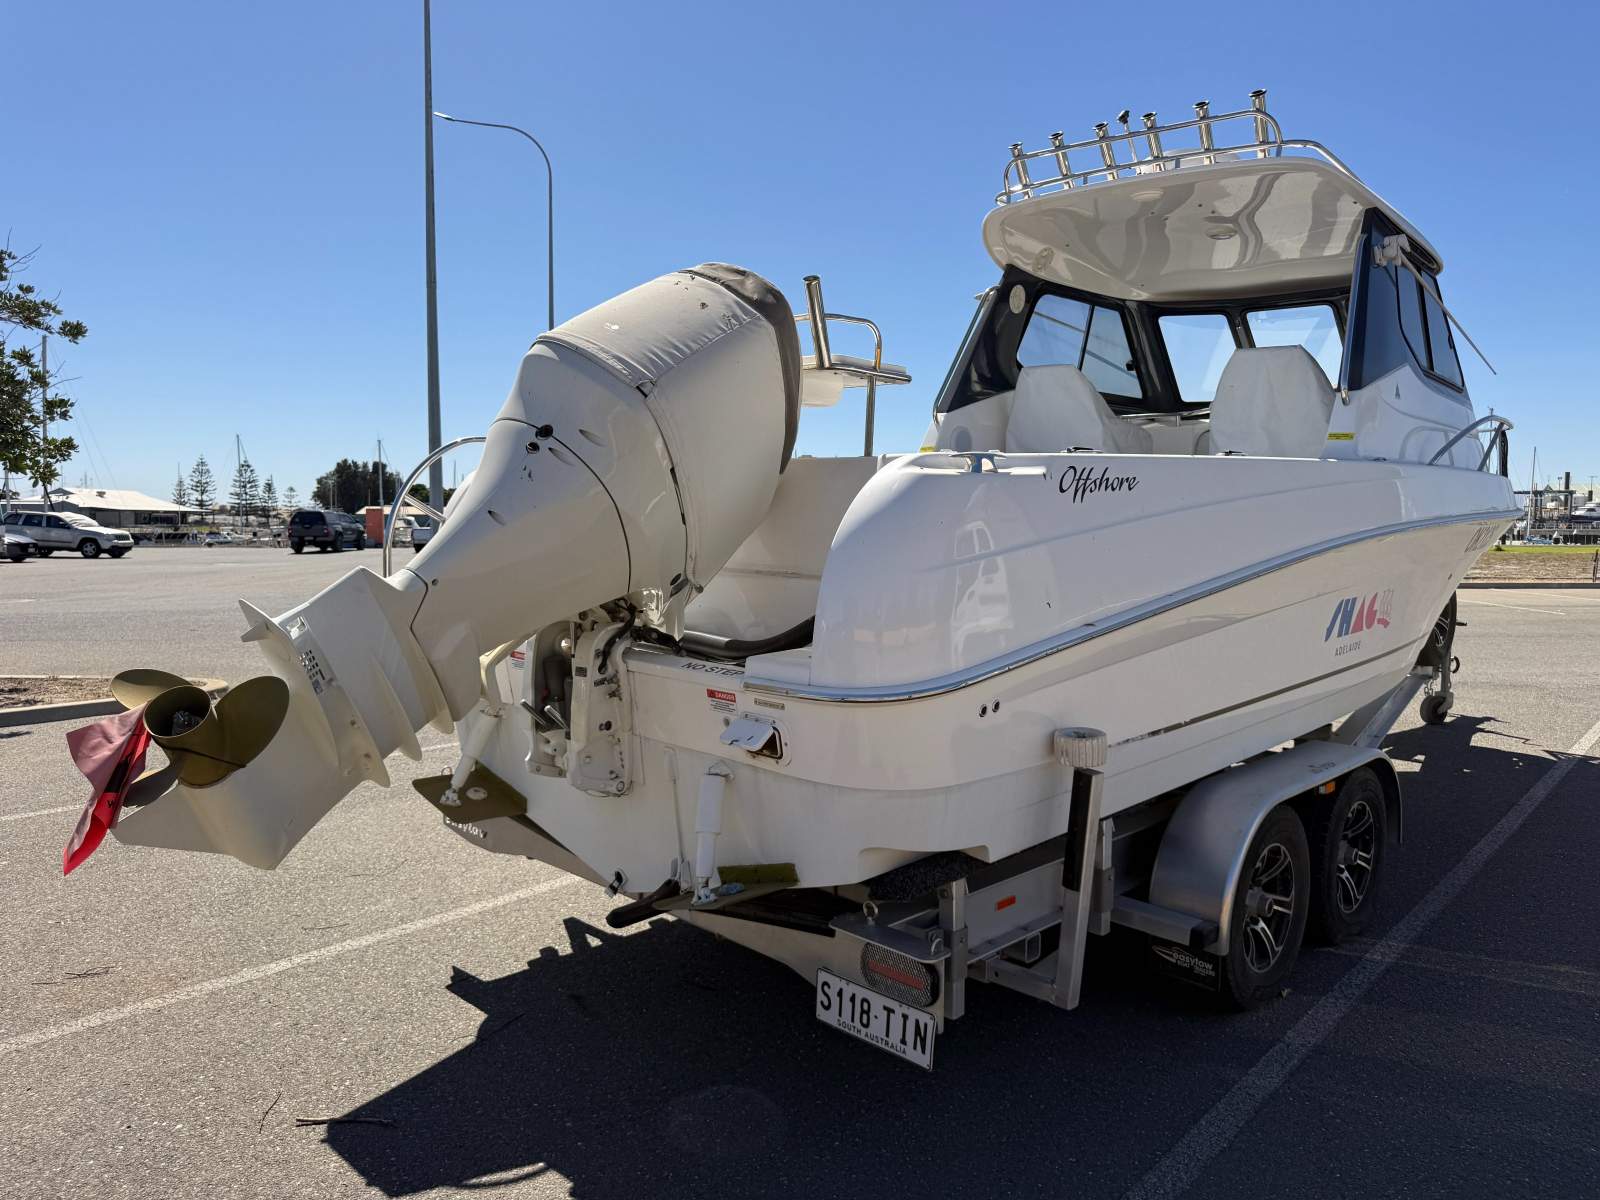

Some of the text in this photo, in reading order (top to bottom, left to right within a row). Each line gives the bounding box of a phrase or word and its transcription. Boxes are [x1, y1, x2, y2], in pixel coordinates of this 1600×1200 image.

[1059, 465, 1140, 504] Offshore
[1335, 641, 1362, 657] ADELAIDE
[681, 662, 745, 677] NO STEP
[837, 1019, 908, 1056] SOUTH AUSTRALIA
